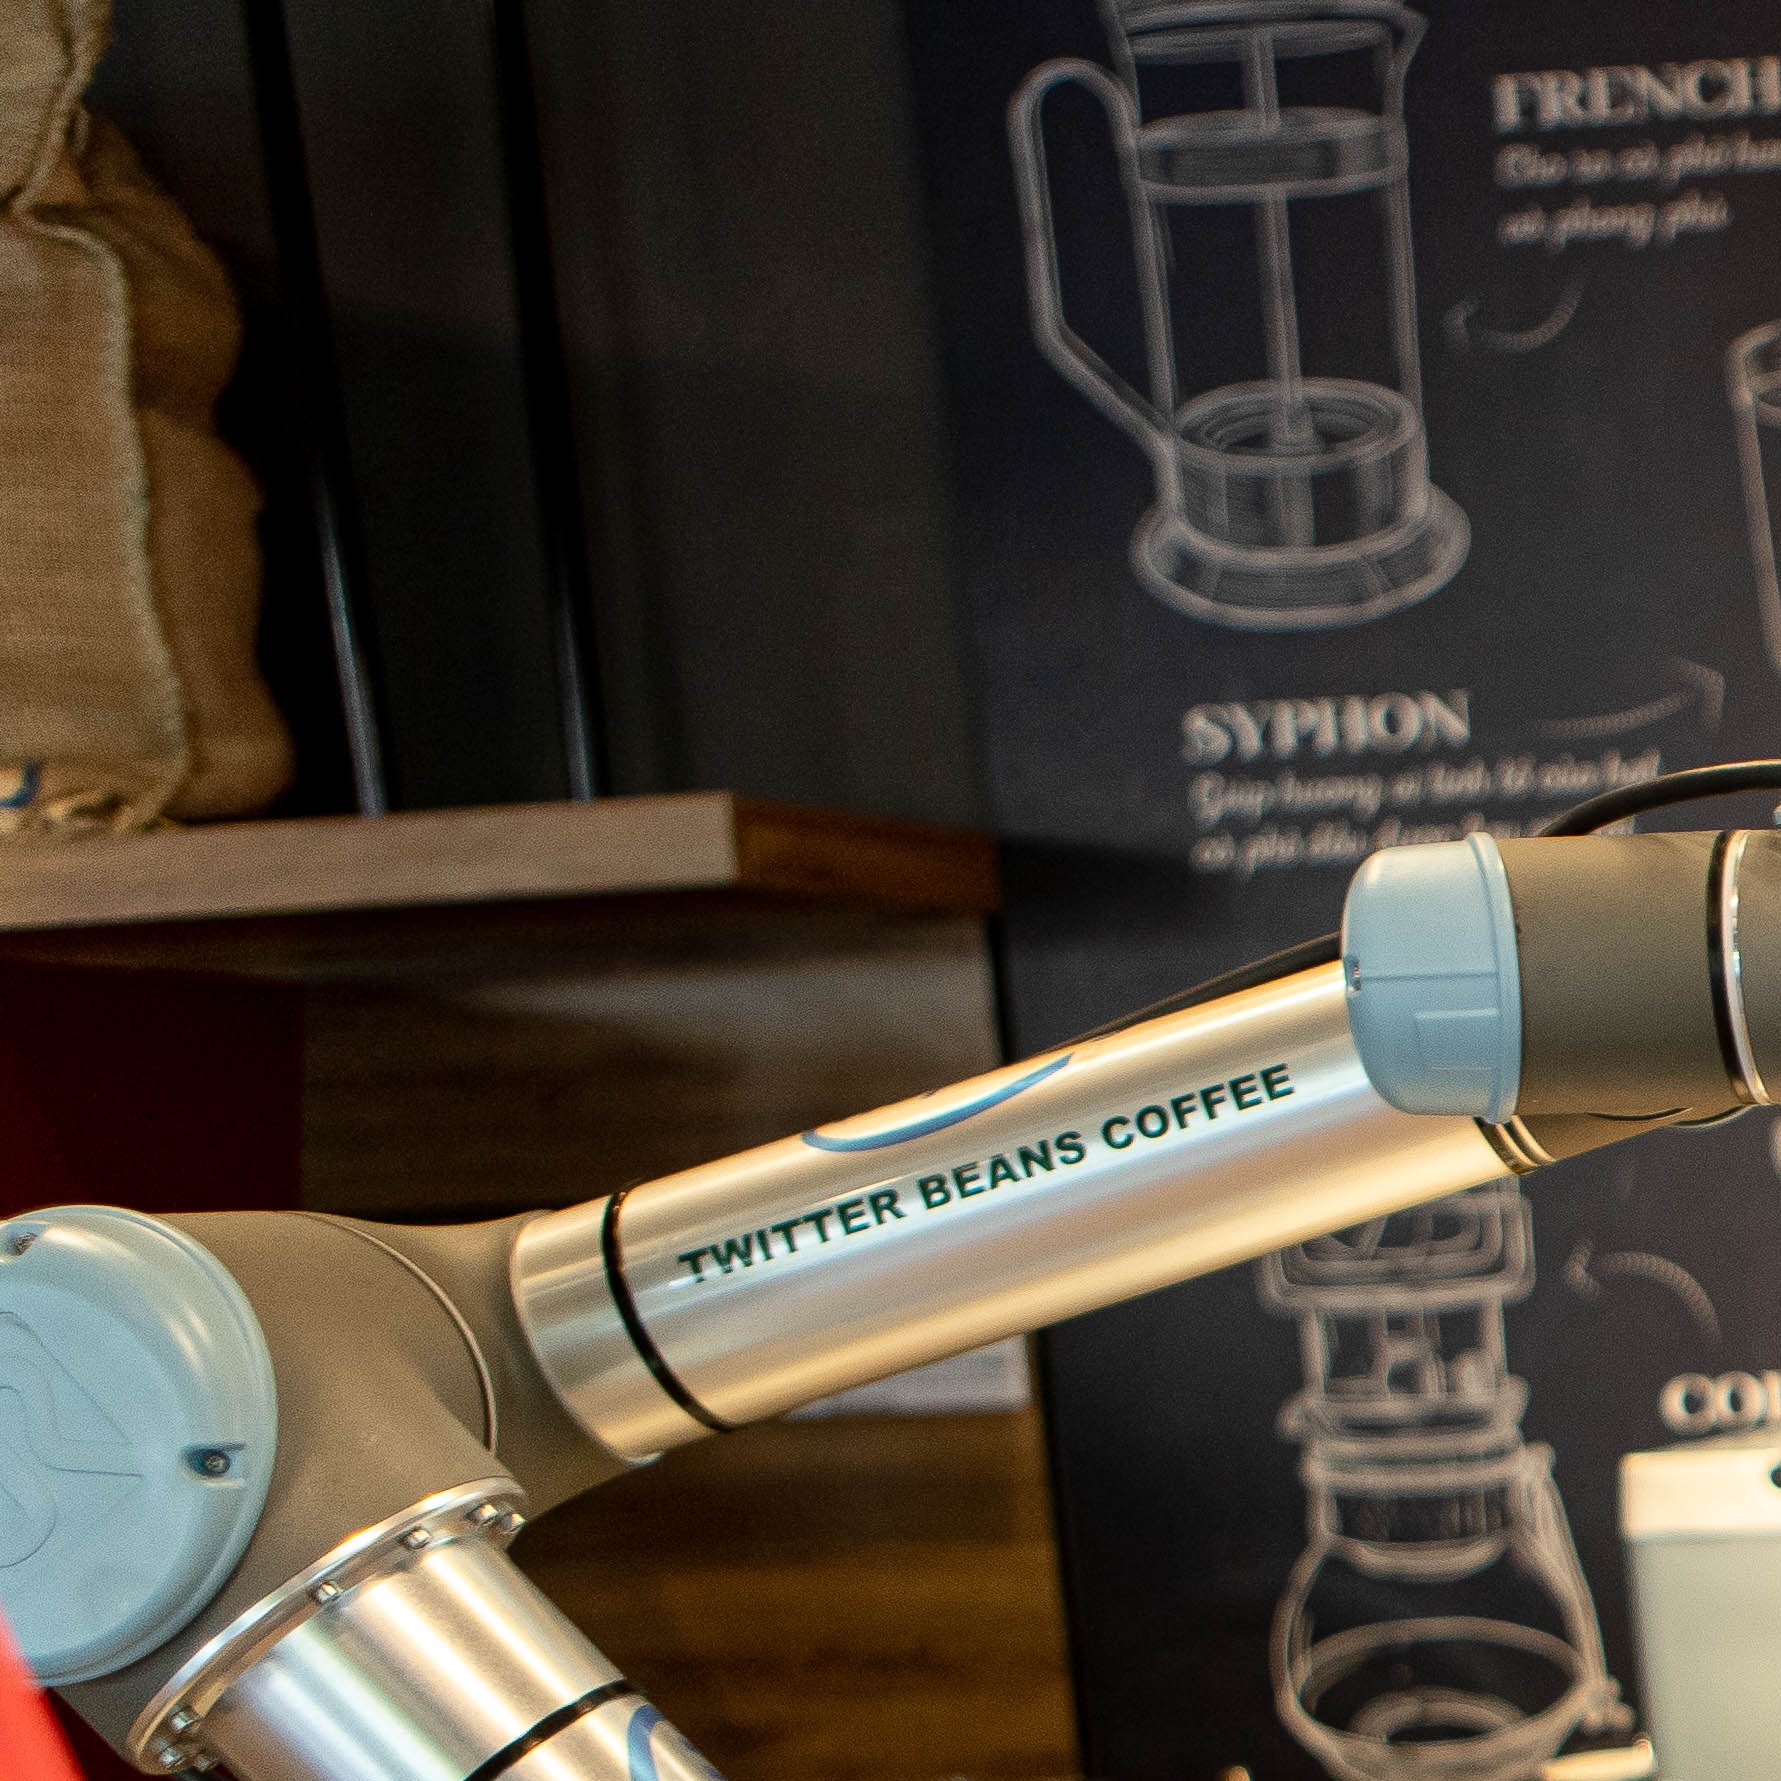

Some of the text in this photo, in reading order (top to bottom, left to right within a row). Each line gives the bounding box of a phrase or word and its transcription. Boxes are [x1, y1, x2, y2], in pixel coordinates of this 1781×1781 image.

[1182, 688, 1472, 767] SYPHON
[677, 1061, 1297, 1284] TWITTER BEANS COFFEE
